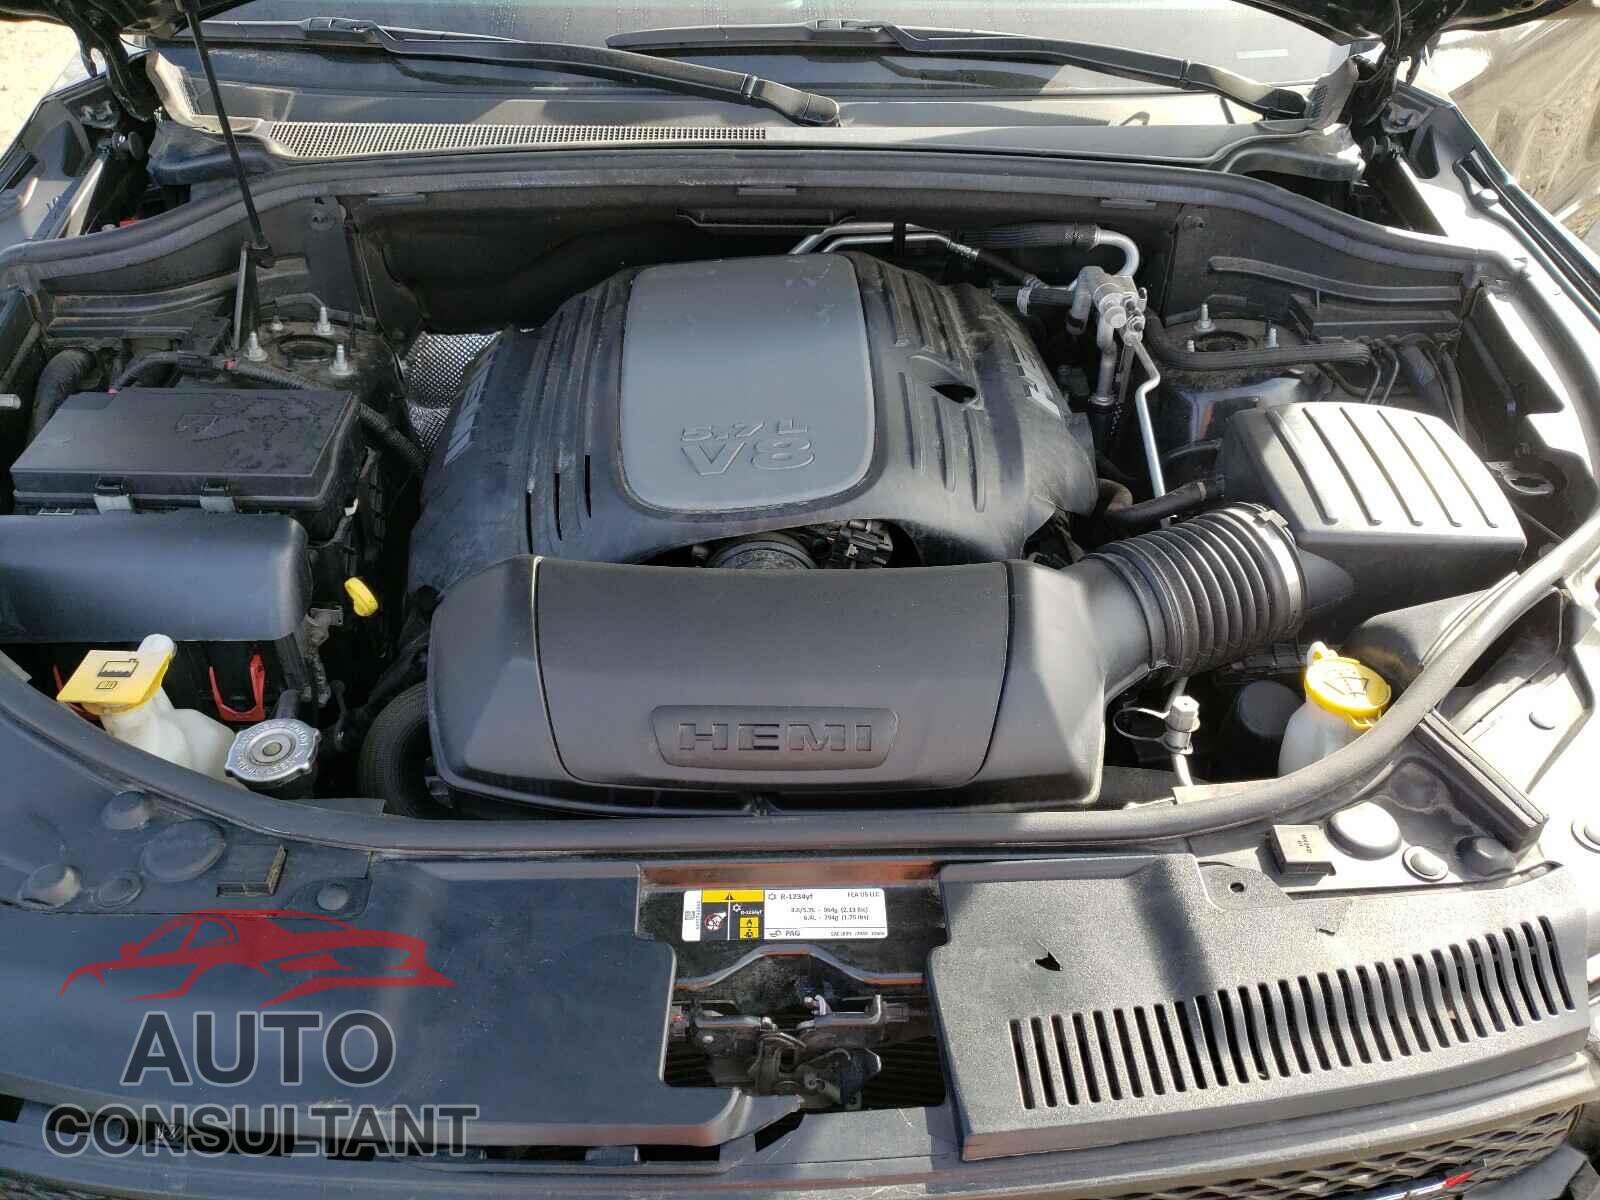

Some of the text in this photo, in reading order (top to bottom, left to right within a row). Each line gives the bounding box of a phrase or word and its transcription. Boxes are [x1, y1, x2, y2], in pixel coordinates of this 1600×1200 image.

[681, 440, 815, 476] V8
[679, 722, 872, 752] HEMI
[780, 892, 813, 901] R-1234yf
